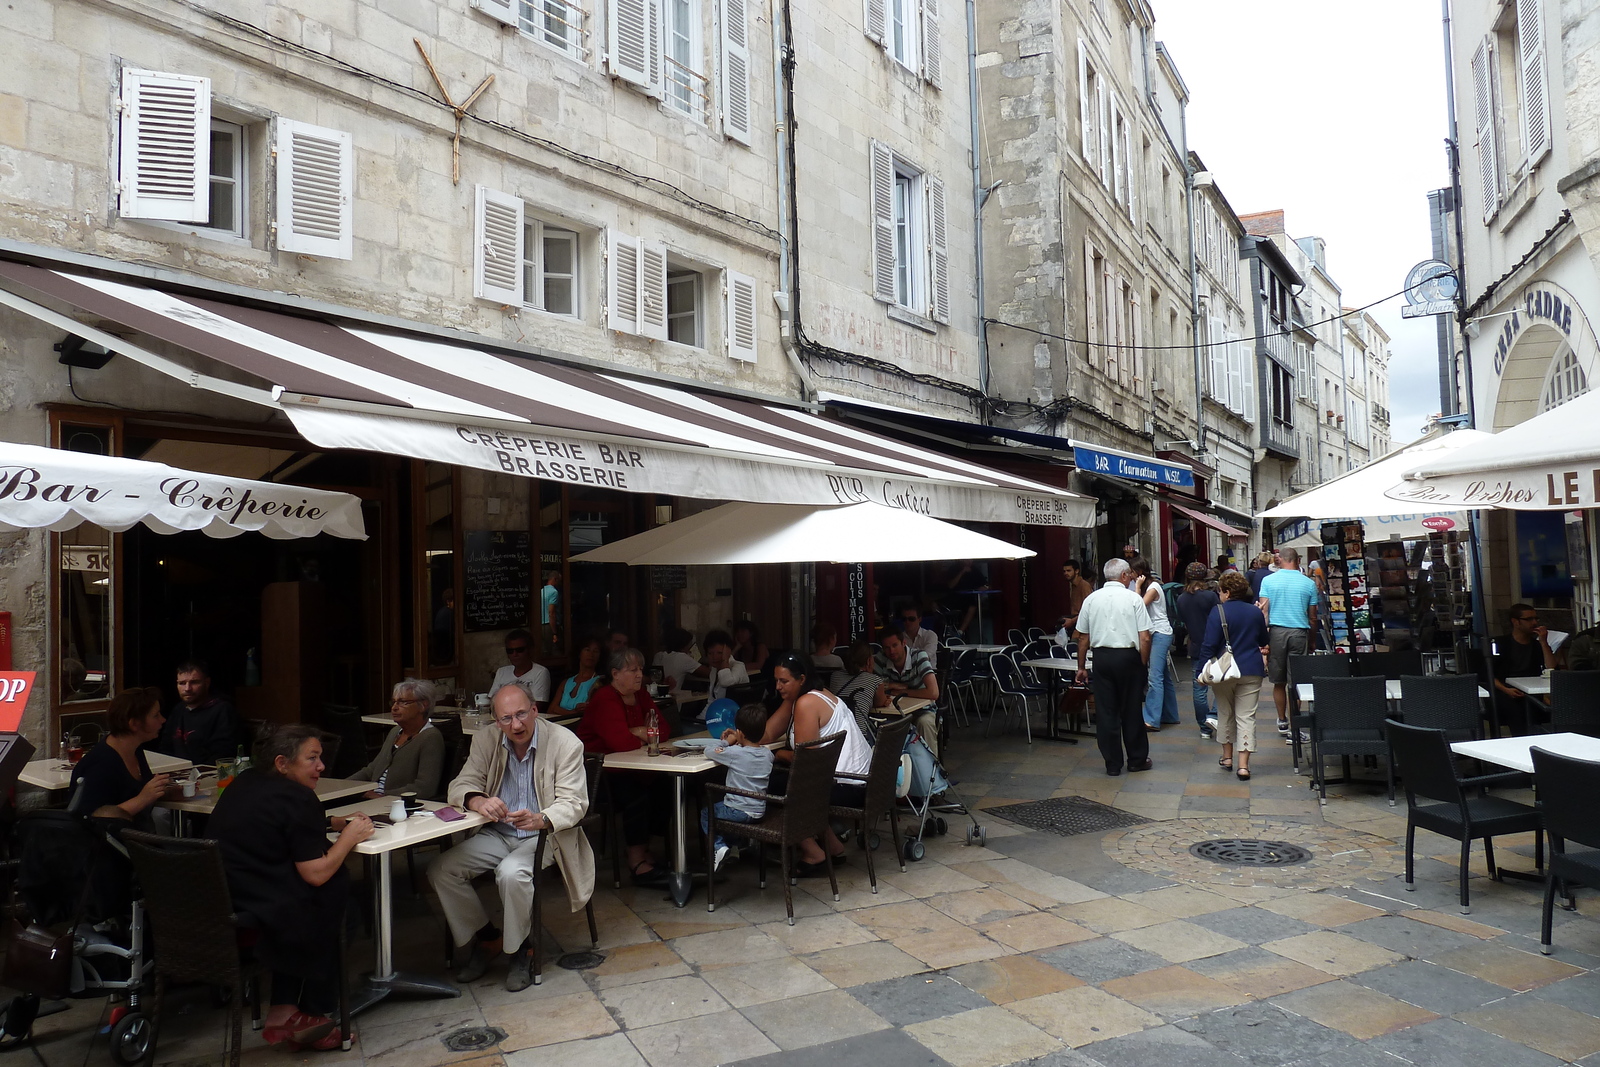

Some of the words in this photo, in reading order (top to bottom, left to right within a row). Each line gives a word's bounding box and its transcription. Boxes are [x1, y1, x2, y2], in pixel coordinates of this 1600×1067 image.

[1527, 289, 1571, 336] CADRE
[456, 427, 586, 461] CRÊPERIE
[598, 443, 645, 468] BAR
[1095, 454, 1110, 471] BAR
[496, 450, 628, 489] BRASSERIE
[1546, 471, 1580, 505] LE
[0, 466, 112, 503] Bar
[159, 477, 329, 524] Crêperie
[1054, 499, 1068, 513] BAR
[1025, 510, 1063, 525] BRASSERIE
[1020, 524, 1028, 603] COCTAILS
[849, 573, 857, 643] CLIMATIS
